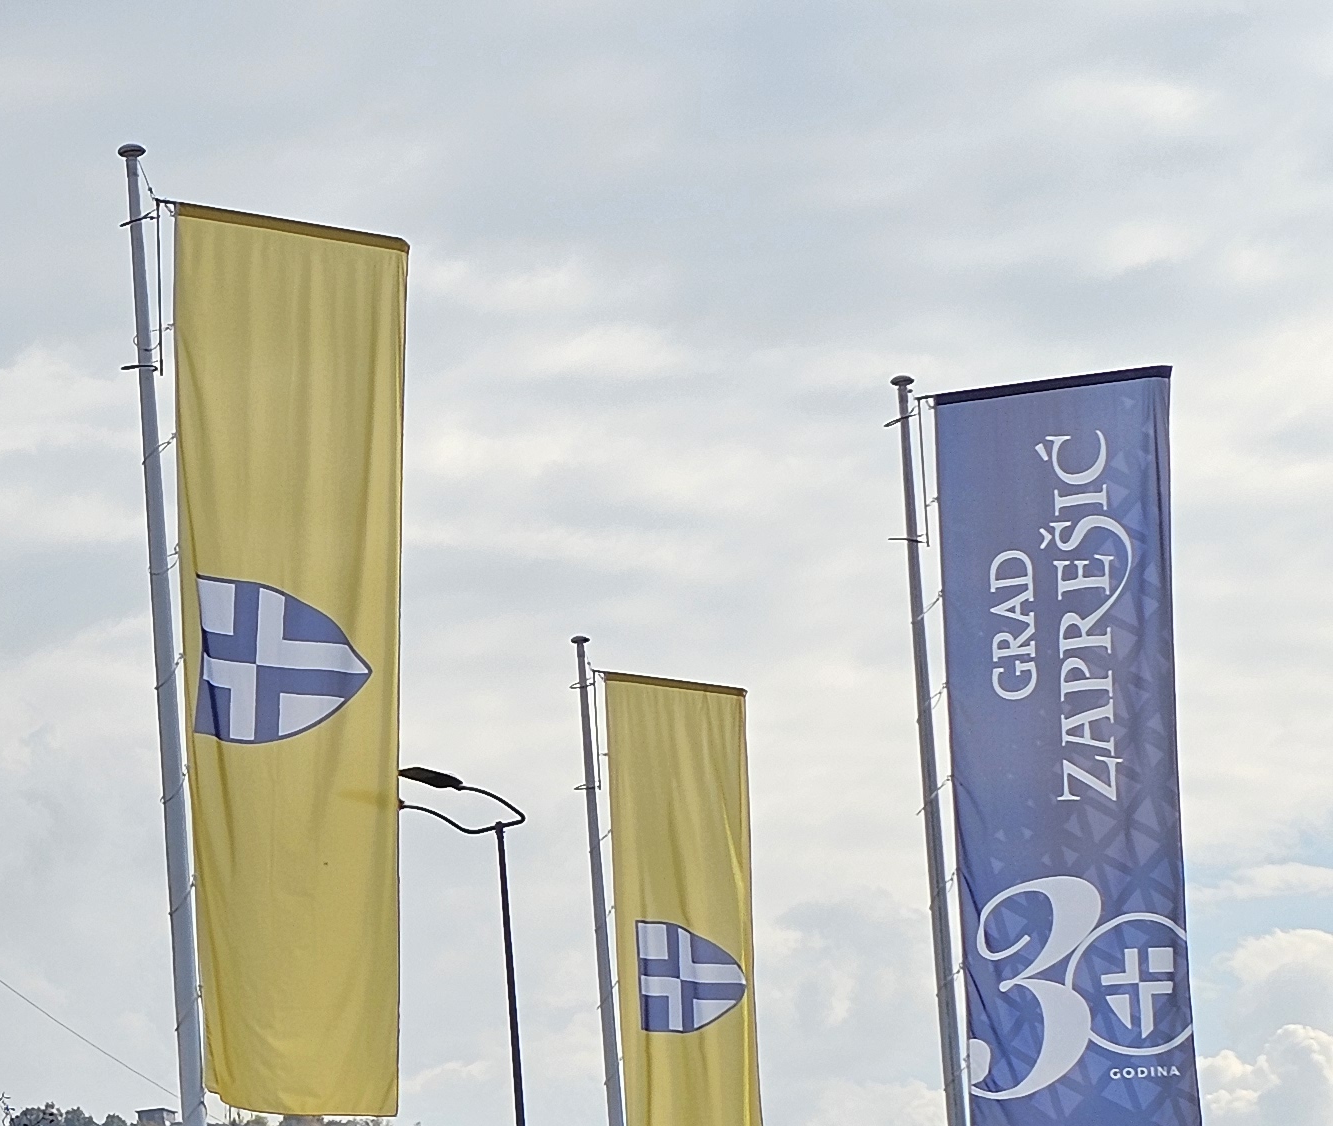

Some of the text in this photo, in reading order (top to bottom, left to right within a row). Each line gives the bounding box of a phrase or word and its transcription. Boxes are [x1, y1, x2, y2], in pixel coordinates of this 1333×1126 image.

[989, 549, 1039, 701] GRAD
[1034, 429, 1133, 802] ZAPREŠIĆ
[970, 875, 1194, 1100] 30
[1109, 1065, 1181, 1080] GODINA
